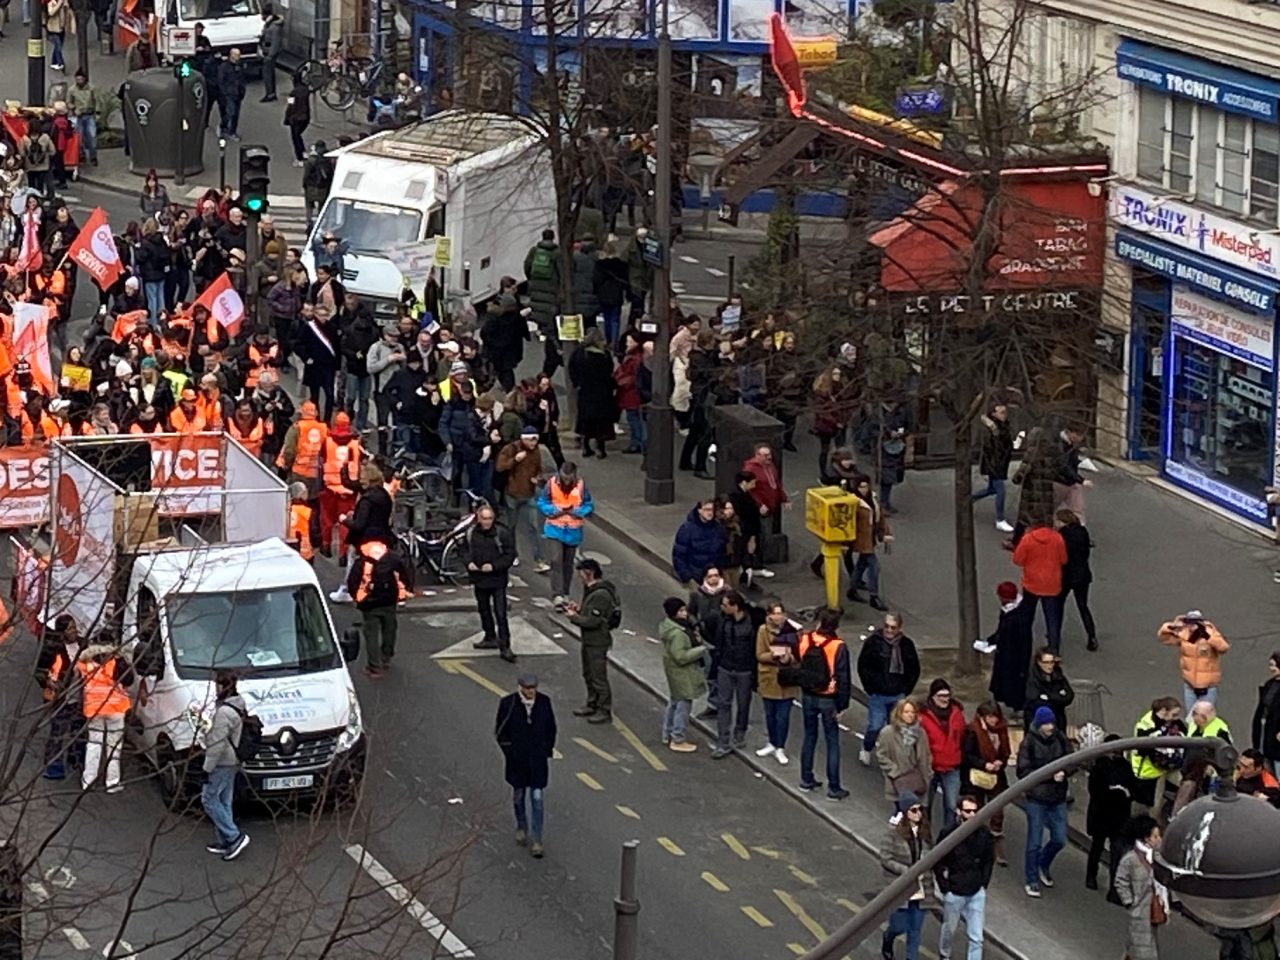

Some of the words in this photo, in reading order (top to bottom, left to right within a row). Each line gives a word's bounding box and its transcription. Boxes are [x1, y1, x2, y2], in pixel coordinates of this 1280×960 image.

[1166, 73, 1220, 104] TRONIX
[1123, 195, 1187, 238] TRONIX
[1211, 227, 1272, 266] Misterpad
[1118, 240, 1176, 276] SPECIALISTE
[1176, 262, 1223, 294] MATERIEL
[1224, 281, 1270, 310] CONSOLE
[1001, 291, 1080, 312] CENTRE
